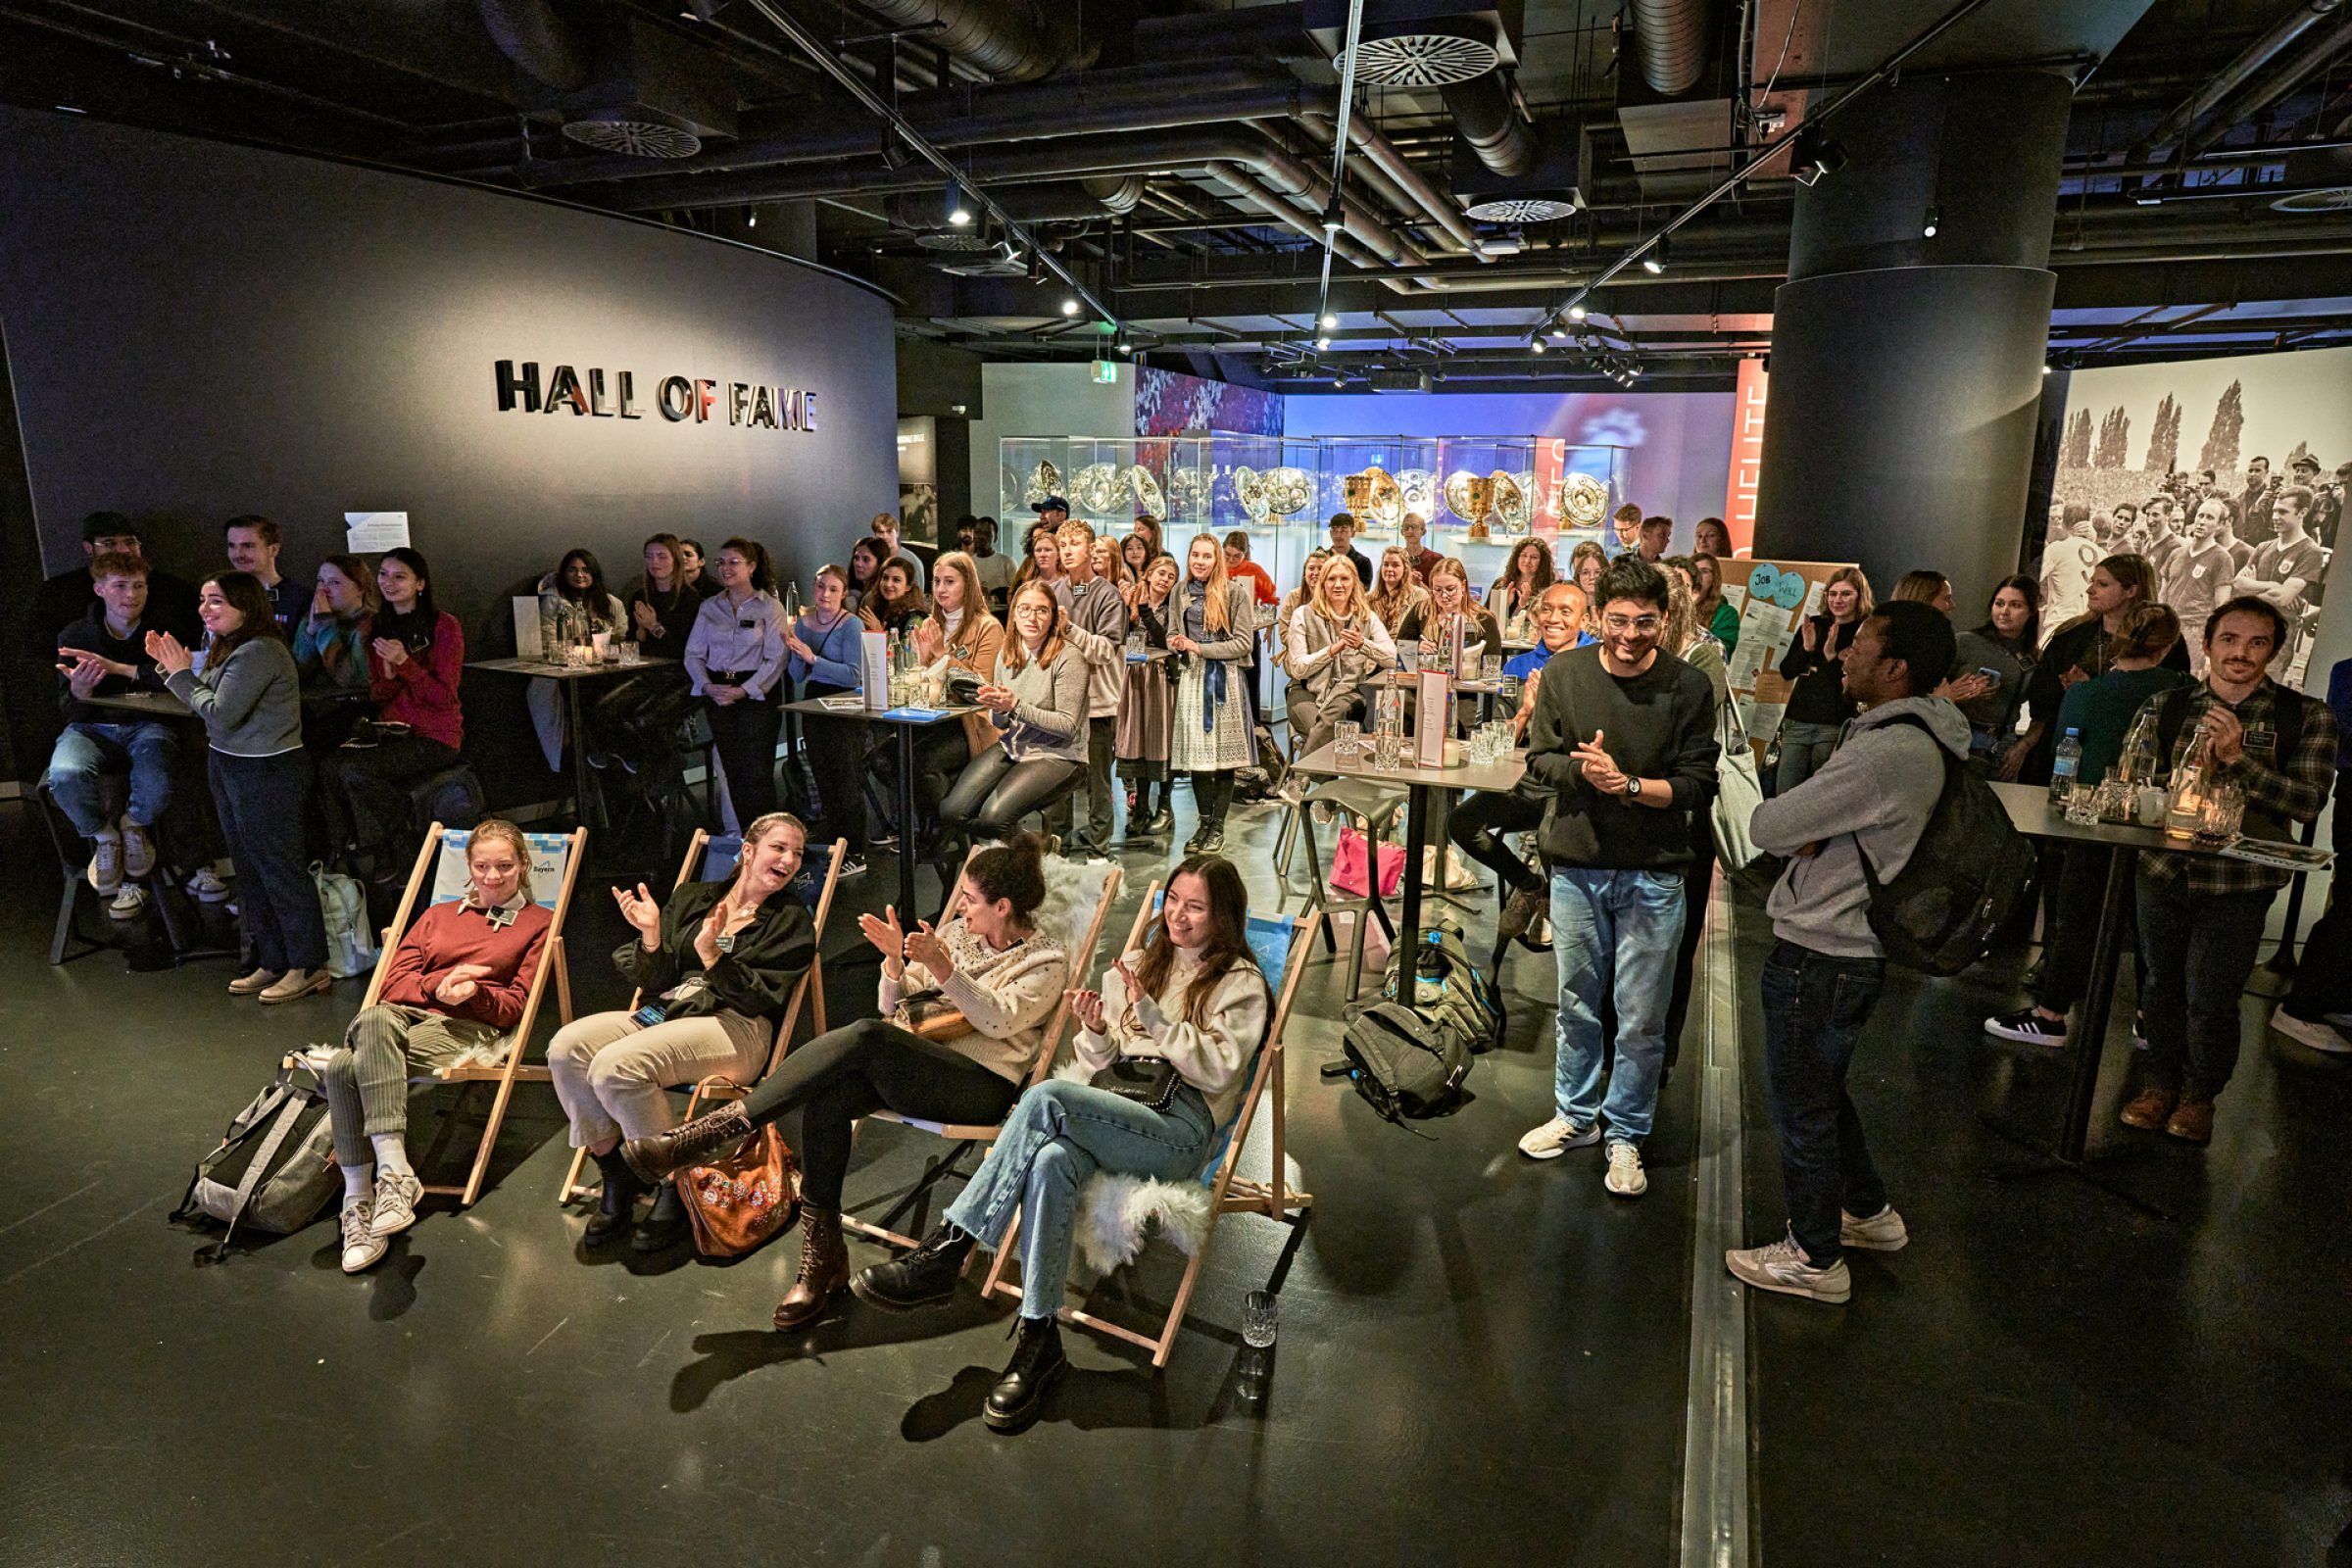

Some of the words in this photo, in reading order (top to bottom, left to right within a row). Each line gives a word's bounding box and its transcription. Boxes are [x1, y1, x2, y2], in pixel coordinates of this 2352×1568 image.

[494, 360, 642, 419] HALL
[656, 375, 716, 423] OF
[728, 382, 817, 432] FAME
[1754, 573, 1771, 585] JOB
